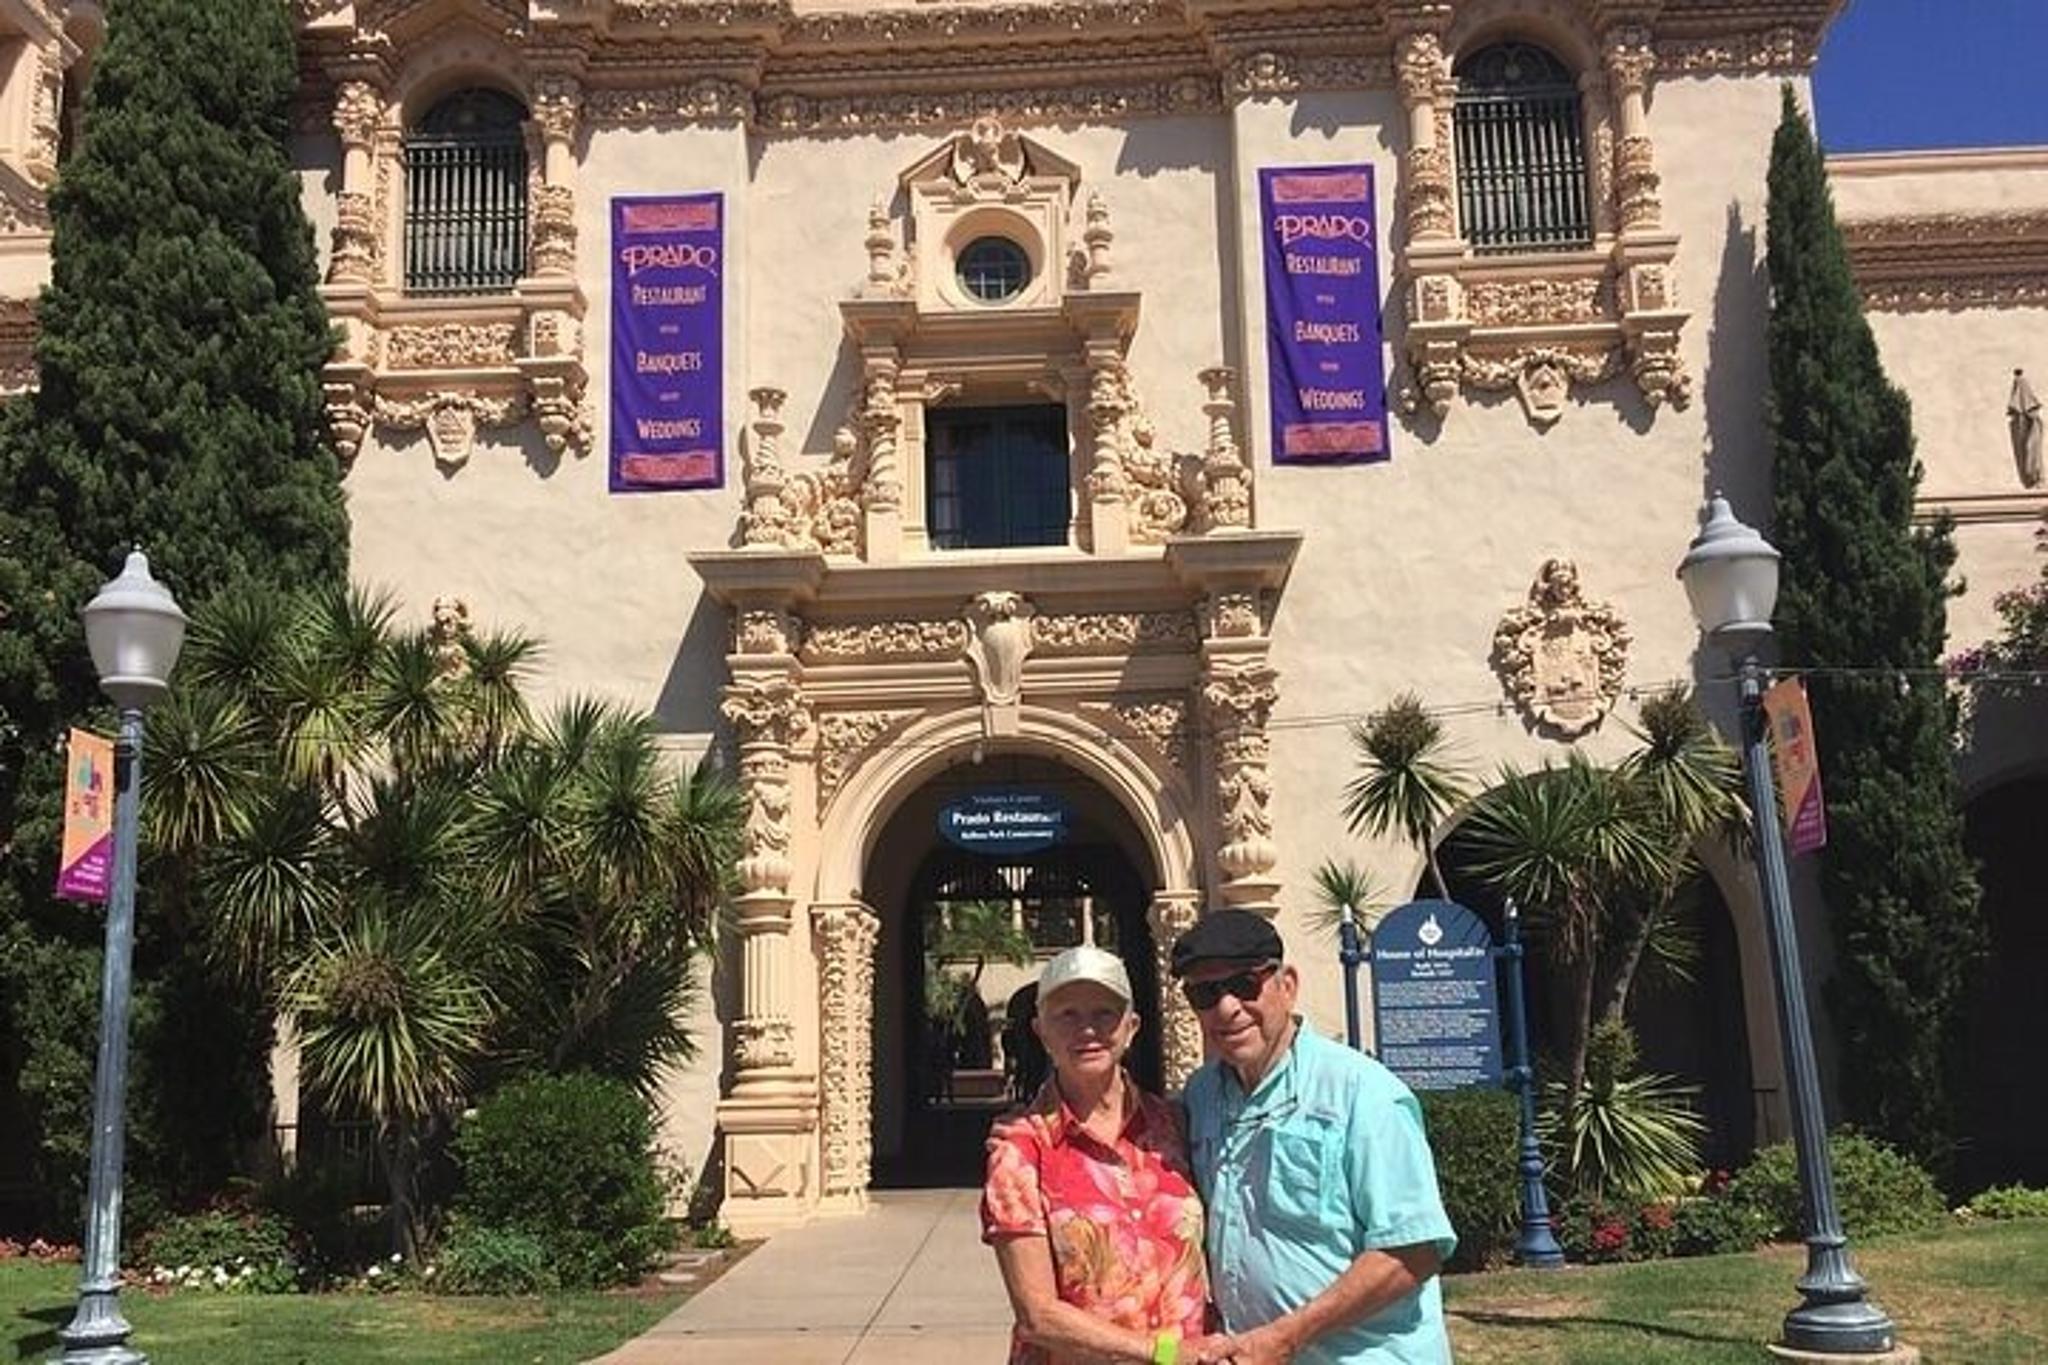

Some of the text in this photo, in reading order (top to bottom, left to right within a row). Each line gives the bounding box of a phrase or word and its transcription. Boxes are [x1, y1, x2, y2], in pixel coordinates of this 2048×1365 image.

[1273, 213, 1370, 248] PRADO
[620, 243, 717, 277] PRADO
[1285, 253, 1361, 275] RESTAURANT
[632, 284, 706, 304] RESTAURANT
[1295, 320, 1360, 345] BANQUETS
[636, 351, 702, 374] BANQUETS
[1300, 388, 1365, 410] WEDDINGS
[636, 418, 701, 438] WEDDINGS
[952, 812, 990, 826] Prado
[1376, 950, 1411, 960] House
[1413, 947, 1425, 959] of
